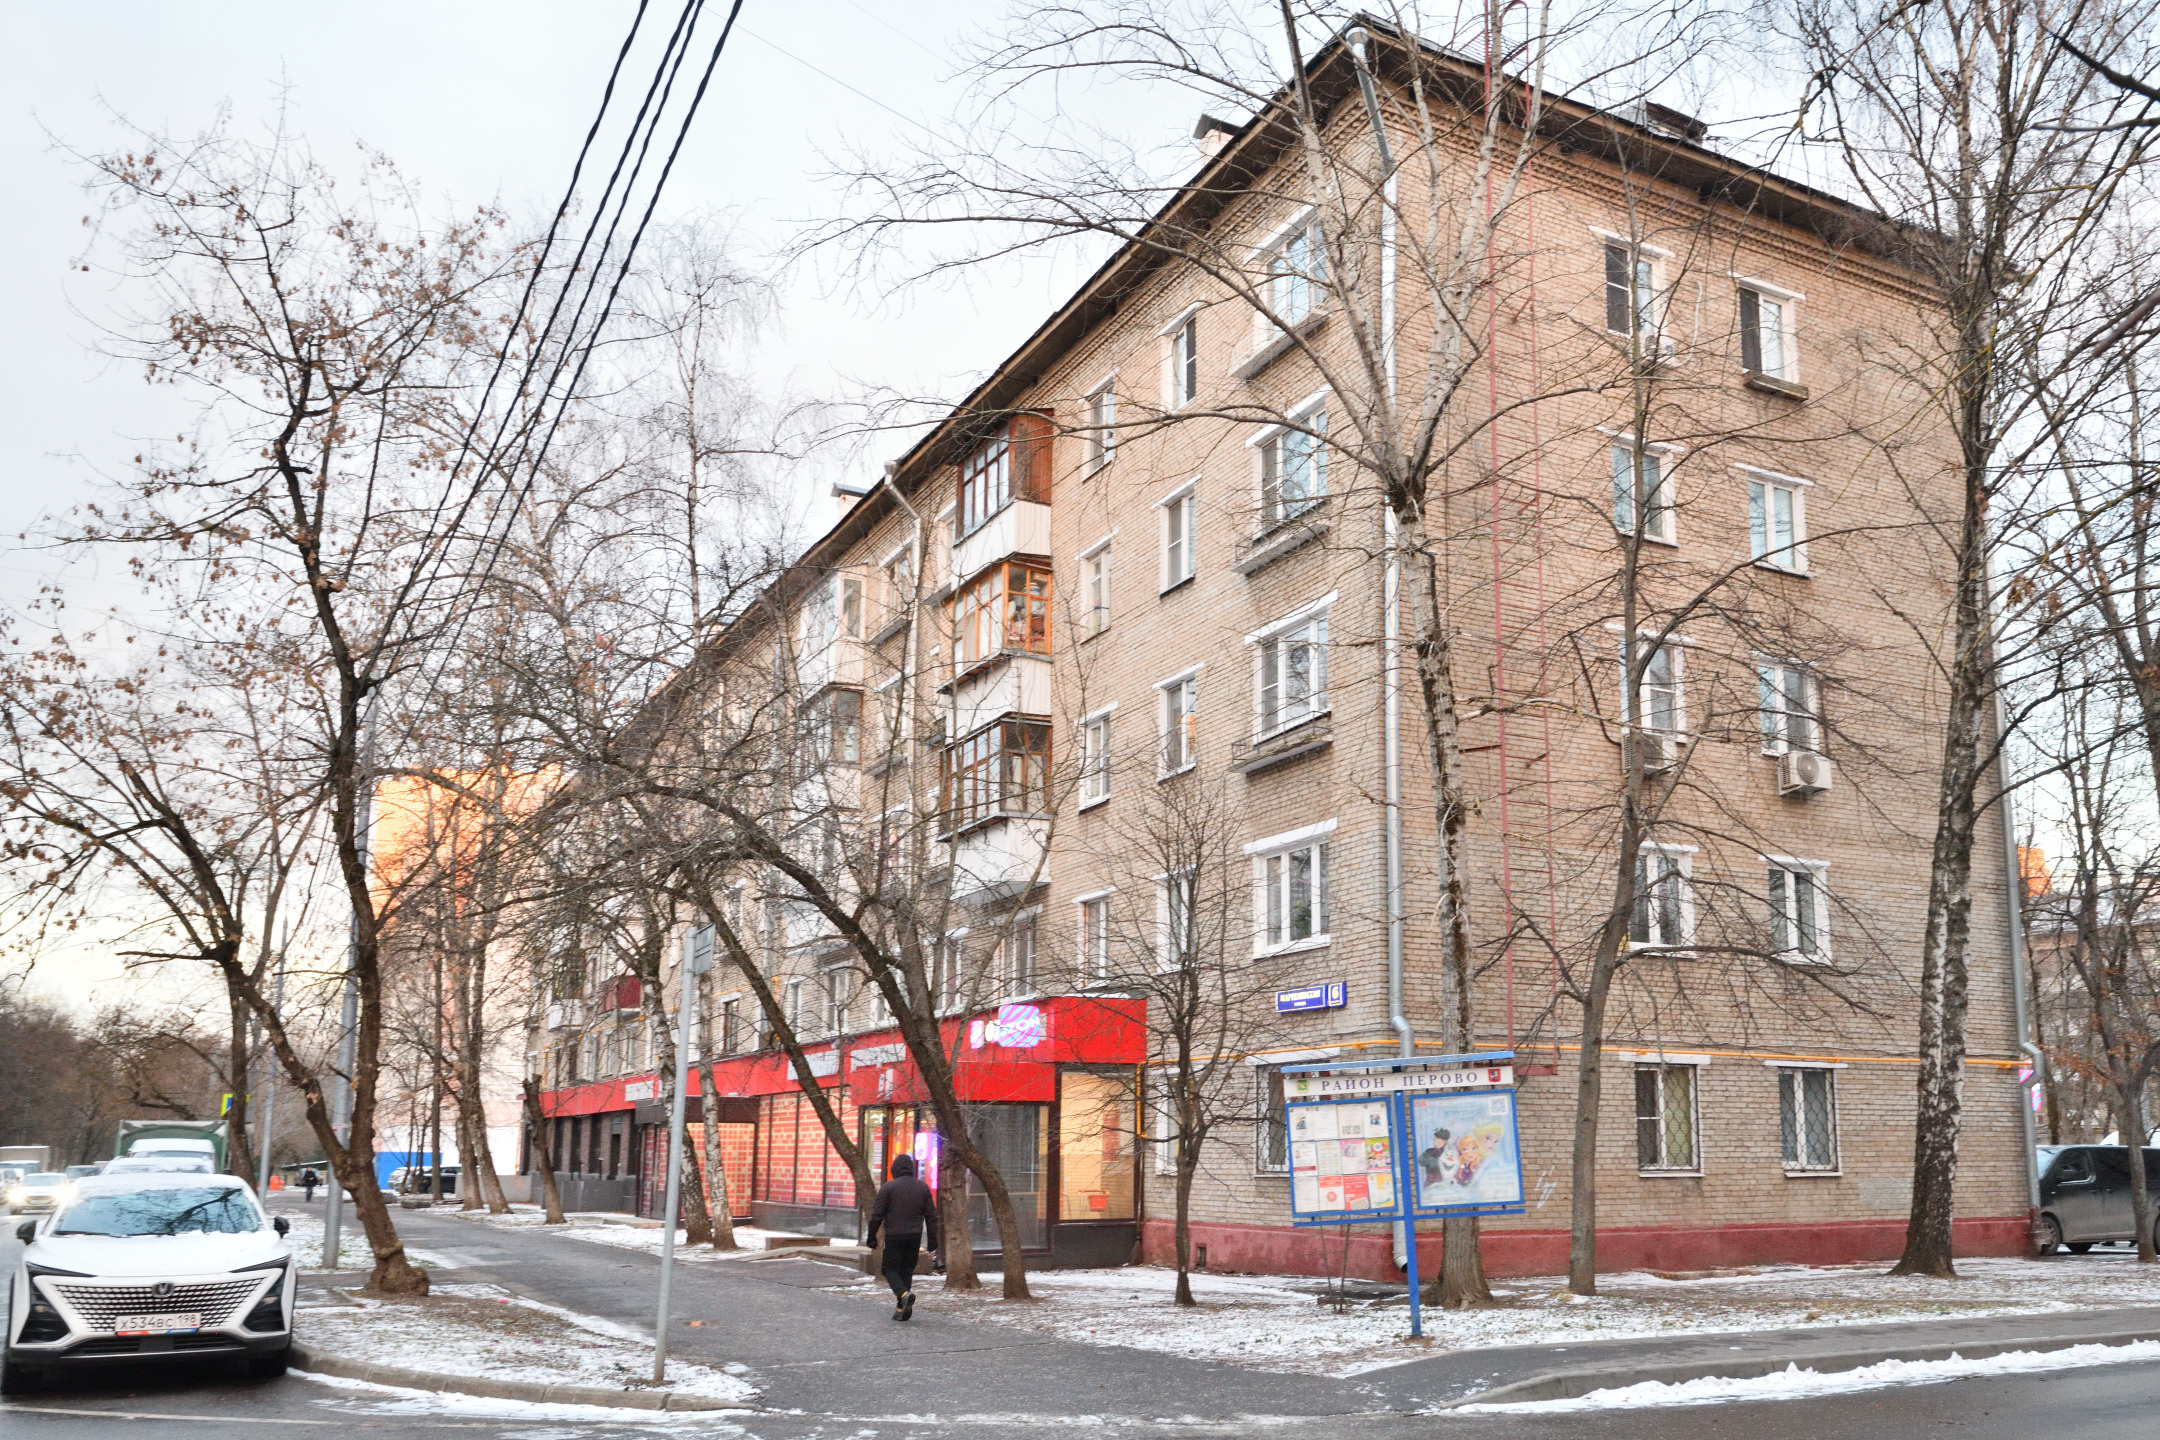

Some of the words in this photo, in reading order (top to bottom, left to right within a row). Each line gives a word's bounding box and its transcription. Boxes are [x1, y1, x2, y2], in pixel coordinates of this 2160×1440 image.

[1331, 985, 1340, 1000] 6
[1321, 1076, 1385, 1091] РАЙОН
[1402, 1071, 1478, 1087] ПЕРОВО
